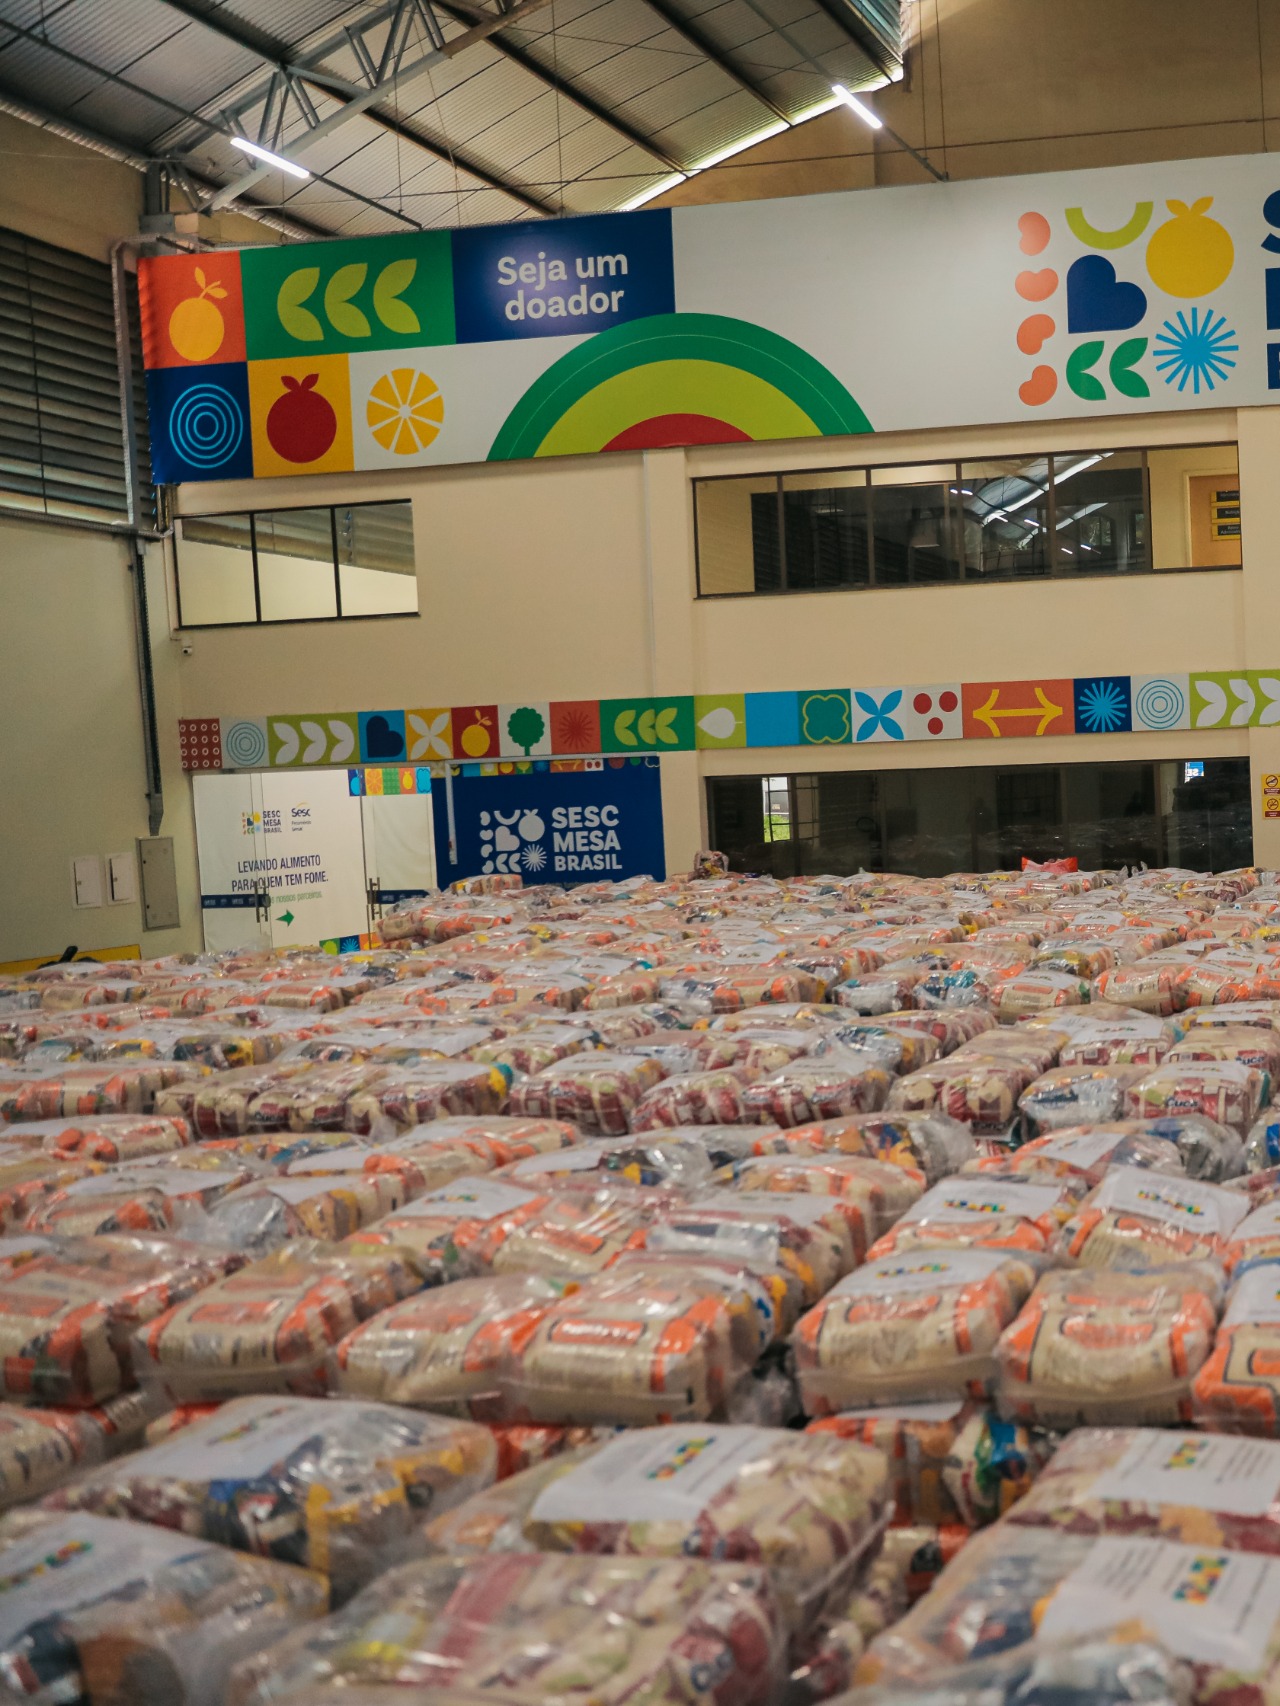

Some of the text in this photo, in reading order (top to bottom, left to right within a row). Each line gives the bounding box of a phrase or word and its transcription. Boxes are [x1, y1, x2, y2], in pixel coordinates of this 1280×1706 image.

[497, 252, 628, 291] Seja um
[505, 284, 625, 321] doador
[263, 810, 280, 818] SESC
[291, 808, 311, 817] Sesc
[551, 805, 619, 829] SESC
[263, 819, 281, 827] MESA
[553, 830, 621, 852] MESA
[238, 855, 321, 873] LEVANDO ALIMENTO
[554, 853, 622, 871] BRASIL
[232, 871, 329, 892] PARA QUEM TEM FOME.
[1165, 1097, 1198, 1108] Cuca
